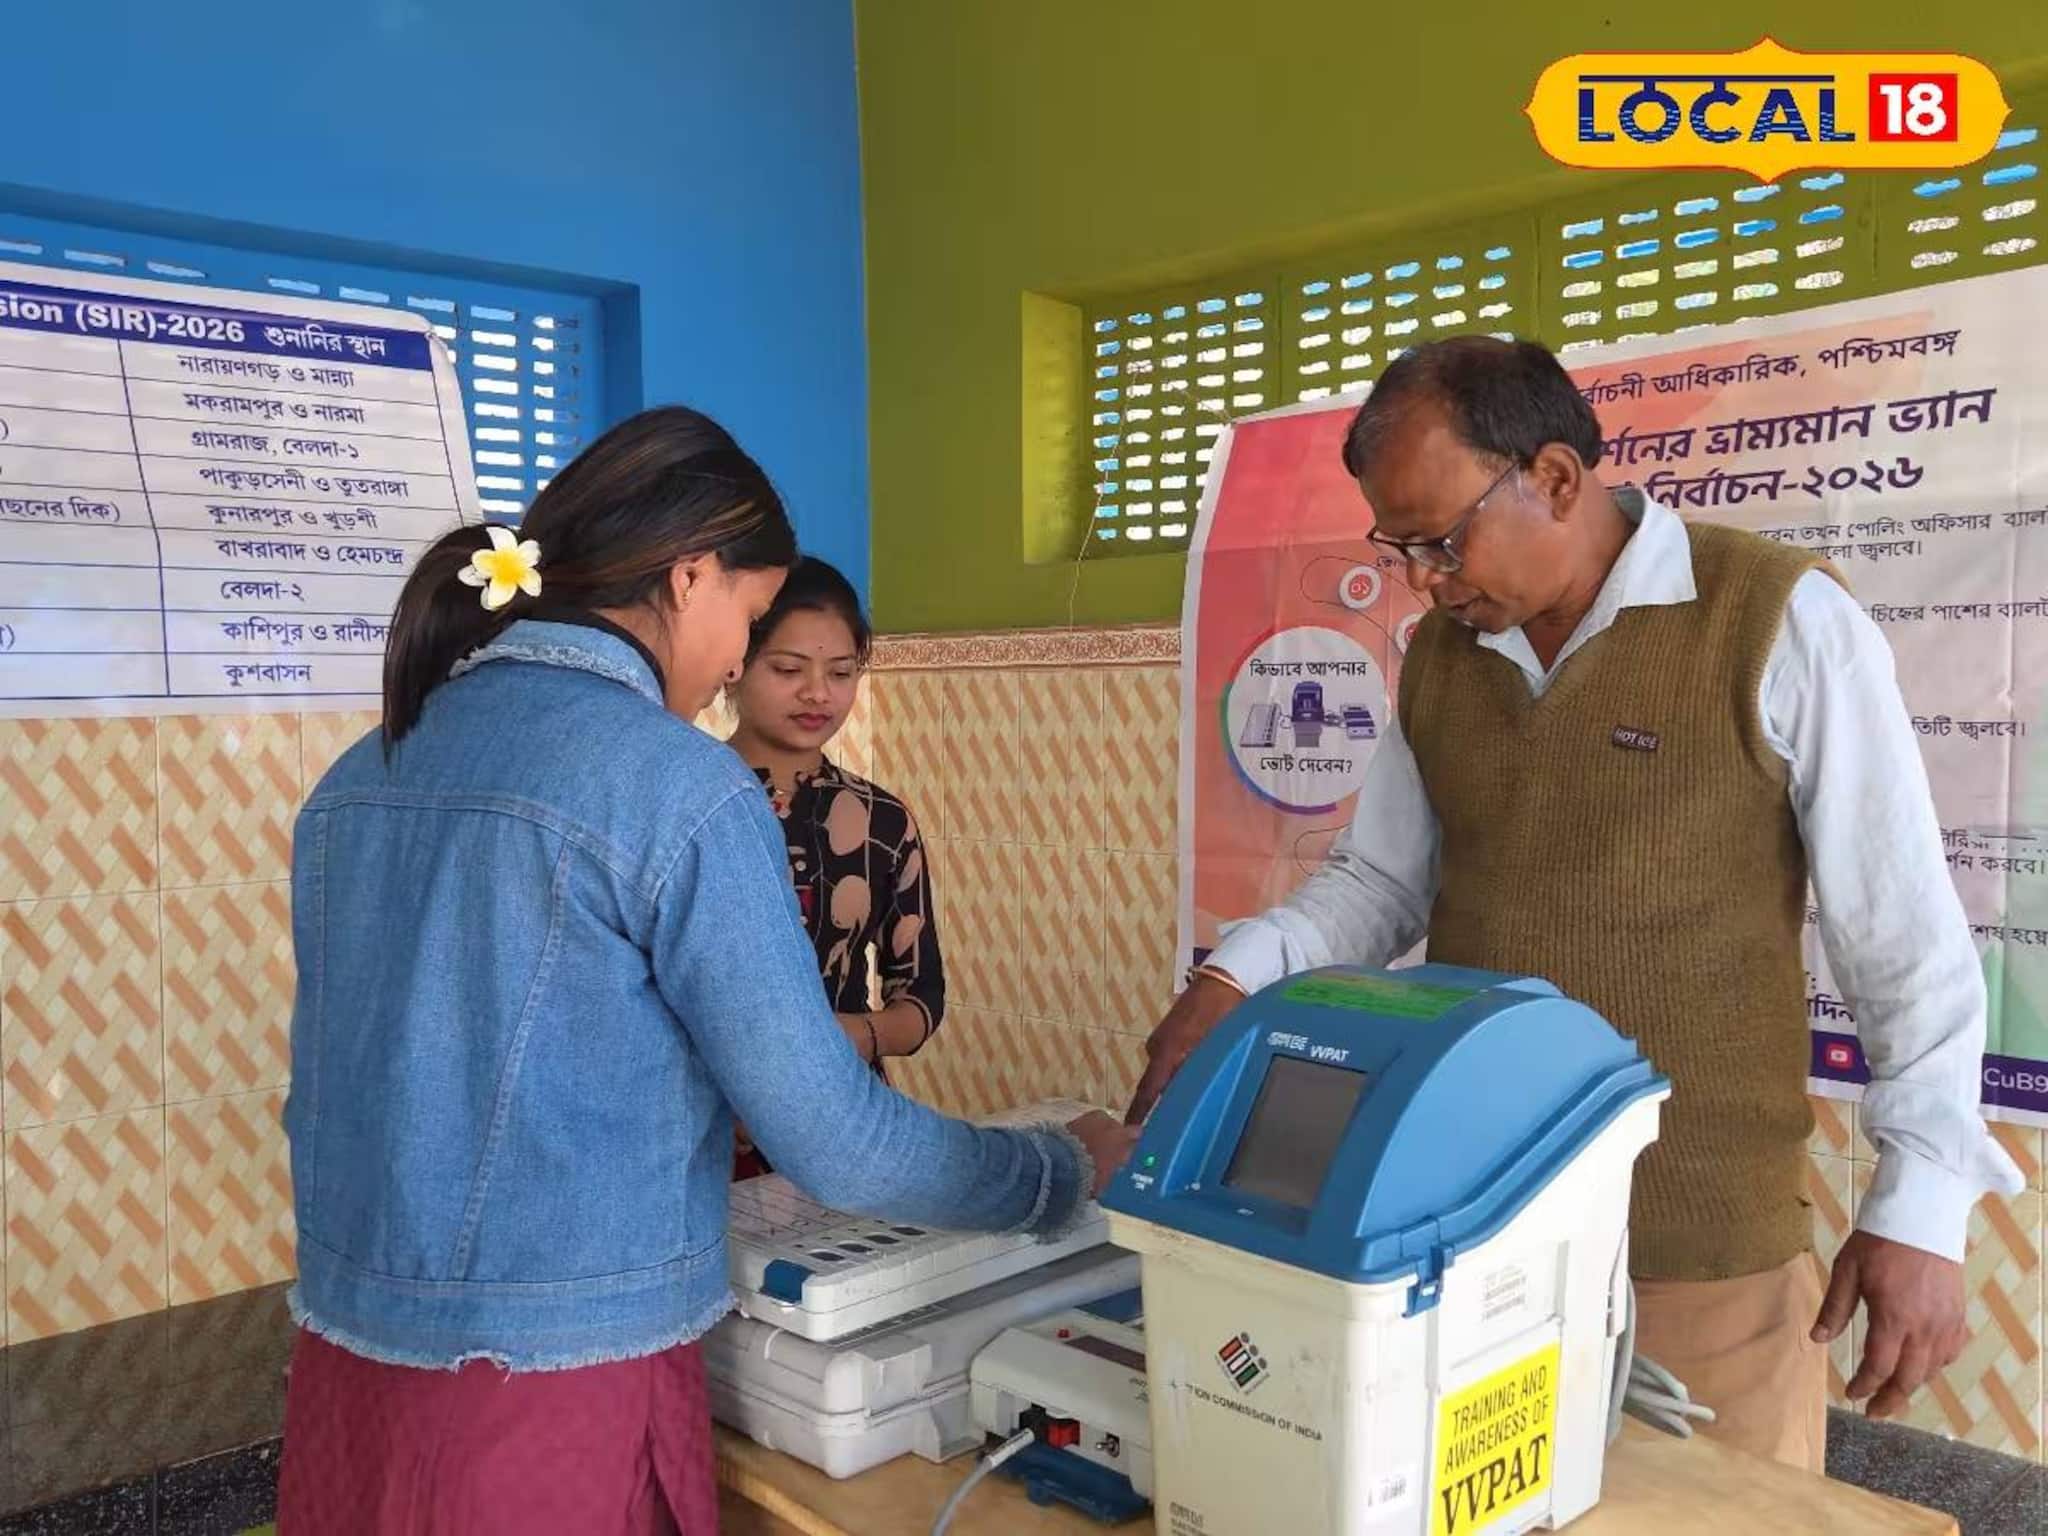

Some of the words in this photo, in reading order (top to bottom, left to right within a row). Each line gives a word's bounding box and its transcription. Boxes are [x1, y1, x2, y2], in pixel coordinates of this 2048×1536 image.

[75, 302, 245, 343] (SIR)-2026
[264, 323, 342, 353] শুনানির
[344, 334, 387, 360] স্থান
[178, 354, 281, 383] নারায়ণগড়
[287, 367, 305, 382] ও
[1578, 371, 1646, 405] র্বাচনী
[1650, 353, 1808, 393] আধিকারিক,
[1818, 329, 1962, 369] পশ্চিমবঙ্গ
[183, 392, 284, 420] মকরামপুর
[289, 402, 308, 418] ও
[313, 402, 365, 424] নারমা
[1600, 426, 1698, 467] র্শনের
[1704, 404, 1876, 455] ভ্রাম্যমান
[1886, 387, 1998, 433] ভ্যান
[282, 436, 360, 459] বেলদা-১
[312, 476, 331, 492] ও
[68, 496, 120, 522] দিক)
[299, 510, 318, 525] ও
[1799, 524, 1841, 541] তখন
[2002, 506, 2048, 529] ব্যাল
[312, 545, 331, 561] ও
[220, 580, 305, 601] বেলদা-২
[220, 615, 305, 646] কাশিপুর
[310, 625, 328, 641] ও
[223, 663, 313, 686] কুশবাসন
[1249, 657, 1304, 677] কিভাবে
[1306, 661, 1368, 677] আপনার
[1260, 753, 1295, 773] ভোট
[1298, 758, 1354, 774] দেবেন?
[1311, 1043, 1350, 1063] VVPAT
[1452, 1381, 1516, 1438] TRAINING
[1520, 1364, 1547, 1402] AND
[1444, 1406, 1529, 1475] AWARENESS
[1531, 1393, 1551, 1426] OF
[1441, 1433, 1548, 1536] VVPAT
